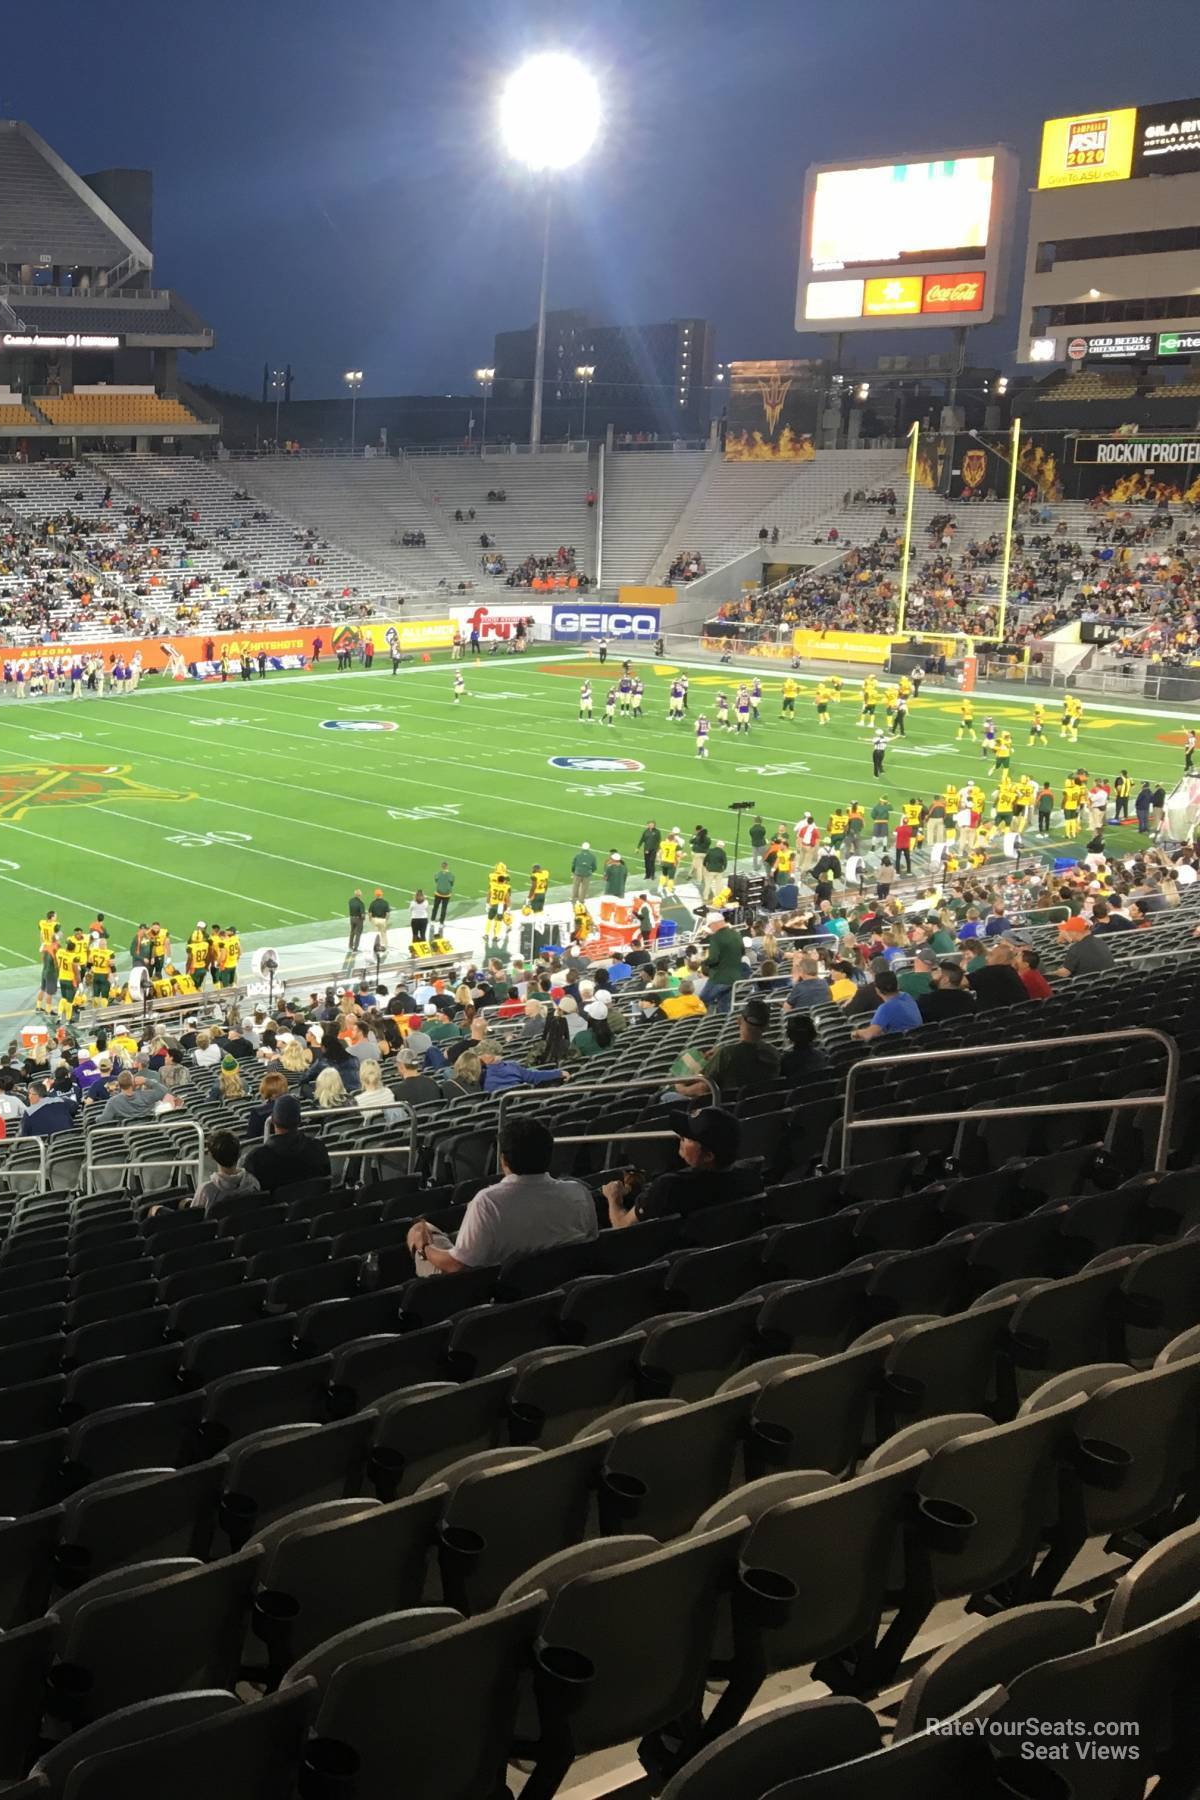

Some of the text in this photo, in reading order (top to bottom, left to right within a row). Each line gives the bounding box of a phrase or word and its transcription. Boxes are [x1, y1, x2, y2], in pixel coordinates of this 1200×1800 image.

[1145, 123, 1179, 139] GILA
[1144, 136, 1176, 147] HOTELS
[1067, 149, 1105, 166] 2020
[1089, 336, 1152, 347] COLD BEERS &
[1089, 344, 1151, 353] CHEESEBURGERS
[1097, 444, 1150, 462] ROCKIN'
[555, 613, 656, 635] GEICO
[21, 647, 72, 657] ARIZONA
[162, 831, 254, 848] 50
[493, 890, 506, 903] 30
[196, 949, 208, 961] 87
[228, 944, 240, 957] 89
[58, 957, 68, 970] 76
[93, 955, 106, 968] 62
